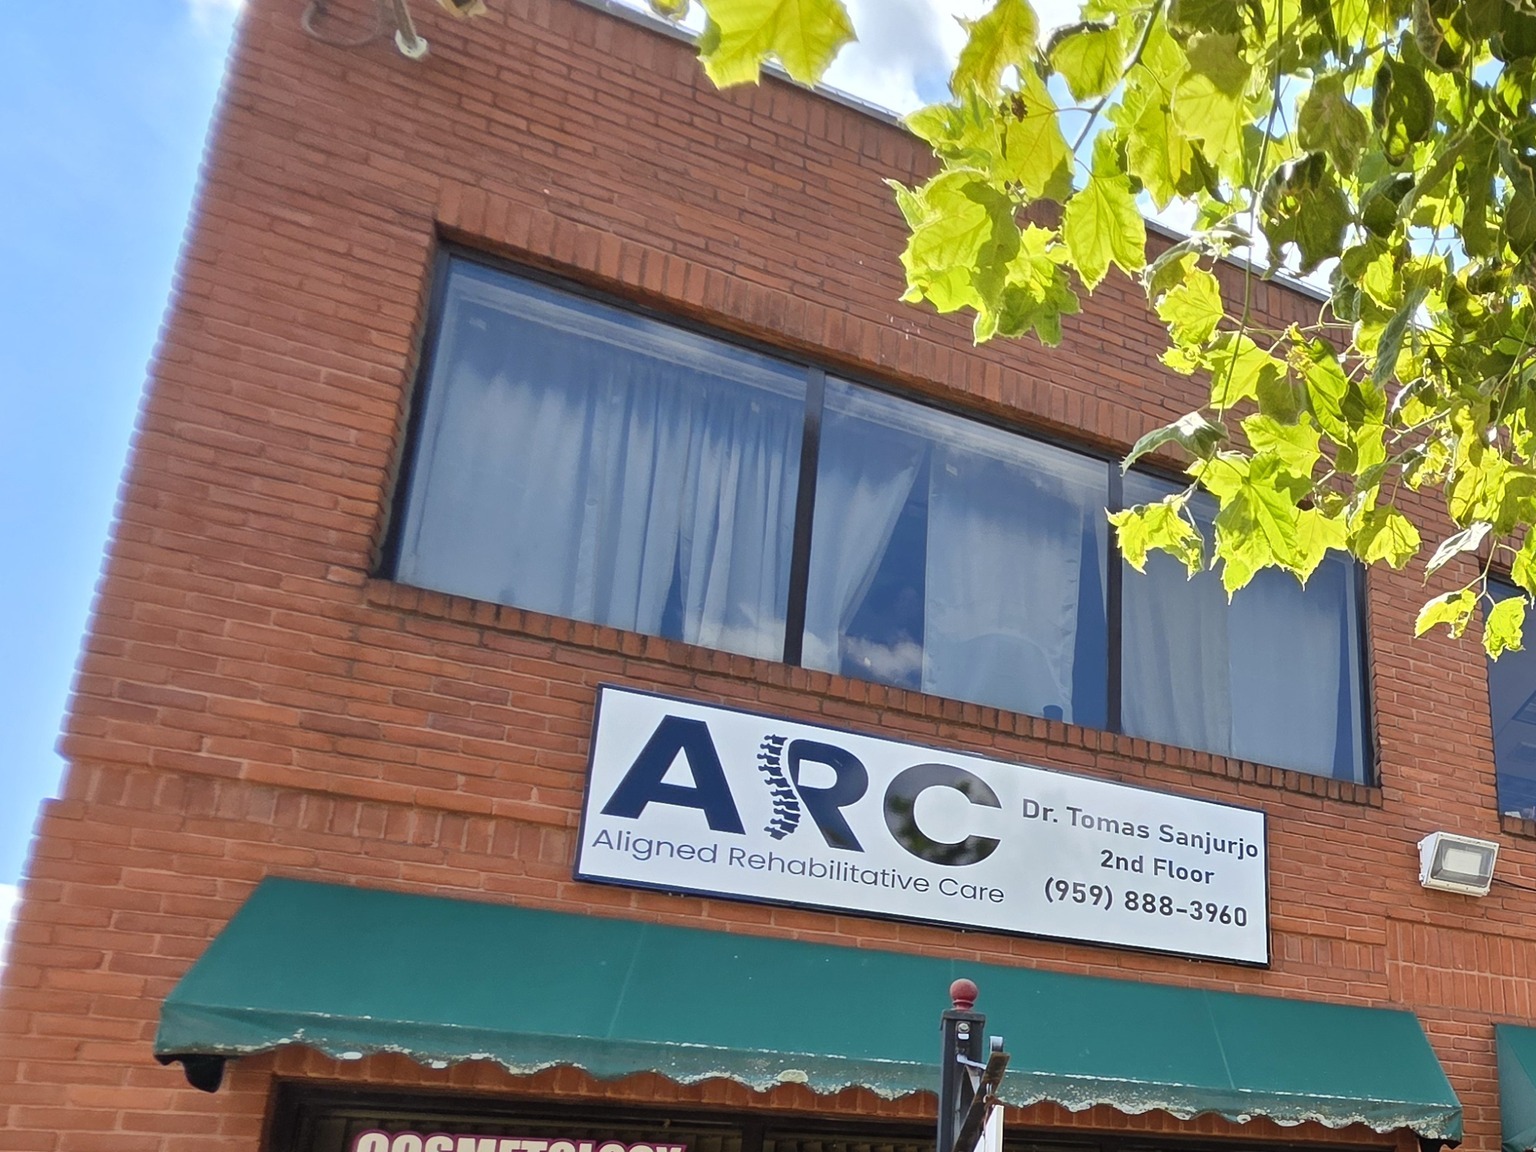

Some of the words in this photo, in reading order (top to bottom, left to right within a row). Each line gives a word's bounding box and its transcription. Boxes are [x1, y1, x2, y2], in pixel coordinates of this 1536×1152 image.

[599, 714, 1002, 867] ARC
[1022, 798, 1058, 823] Dr.
[1066, 806, 1151, 840] Tomas
[1159, 823, 1260, 863] Sanjurjo
[592, 829, 718, 866] Aligned
[728, 847, 930, 894] Rehabilitative
[939, 876, 1005, 904] Care
[1100, 849, 1143, 877] 2nd
[1153, 858, 1215, 885] Floor
[1044, 876, 1113, 912] (959)
[1124, 888, 1248, 928] 888-3960
